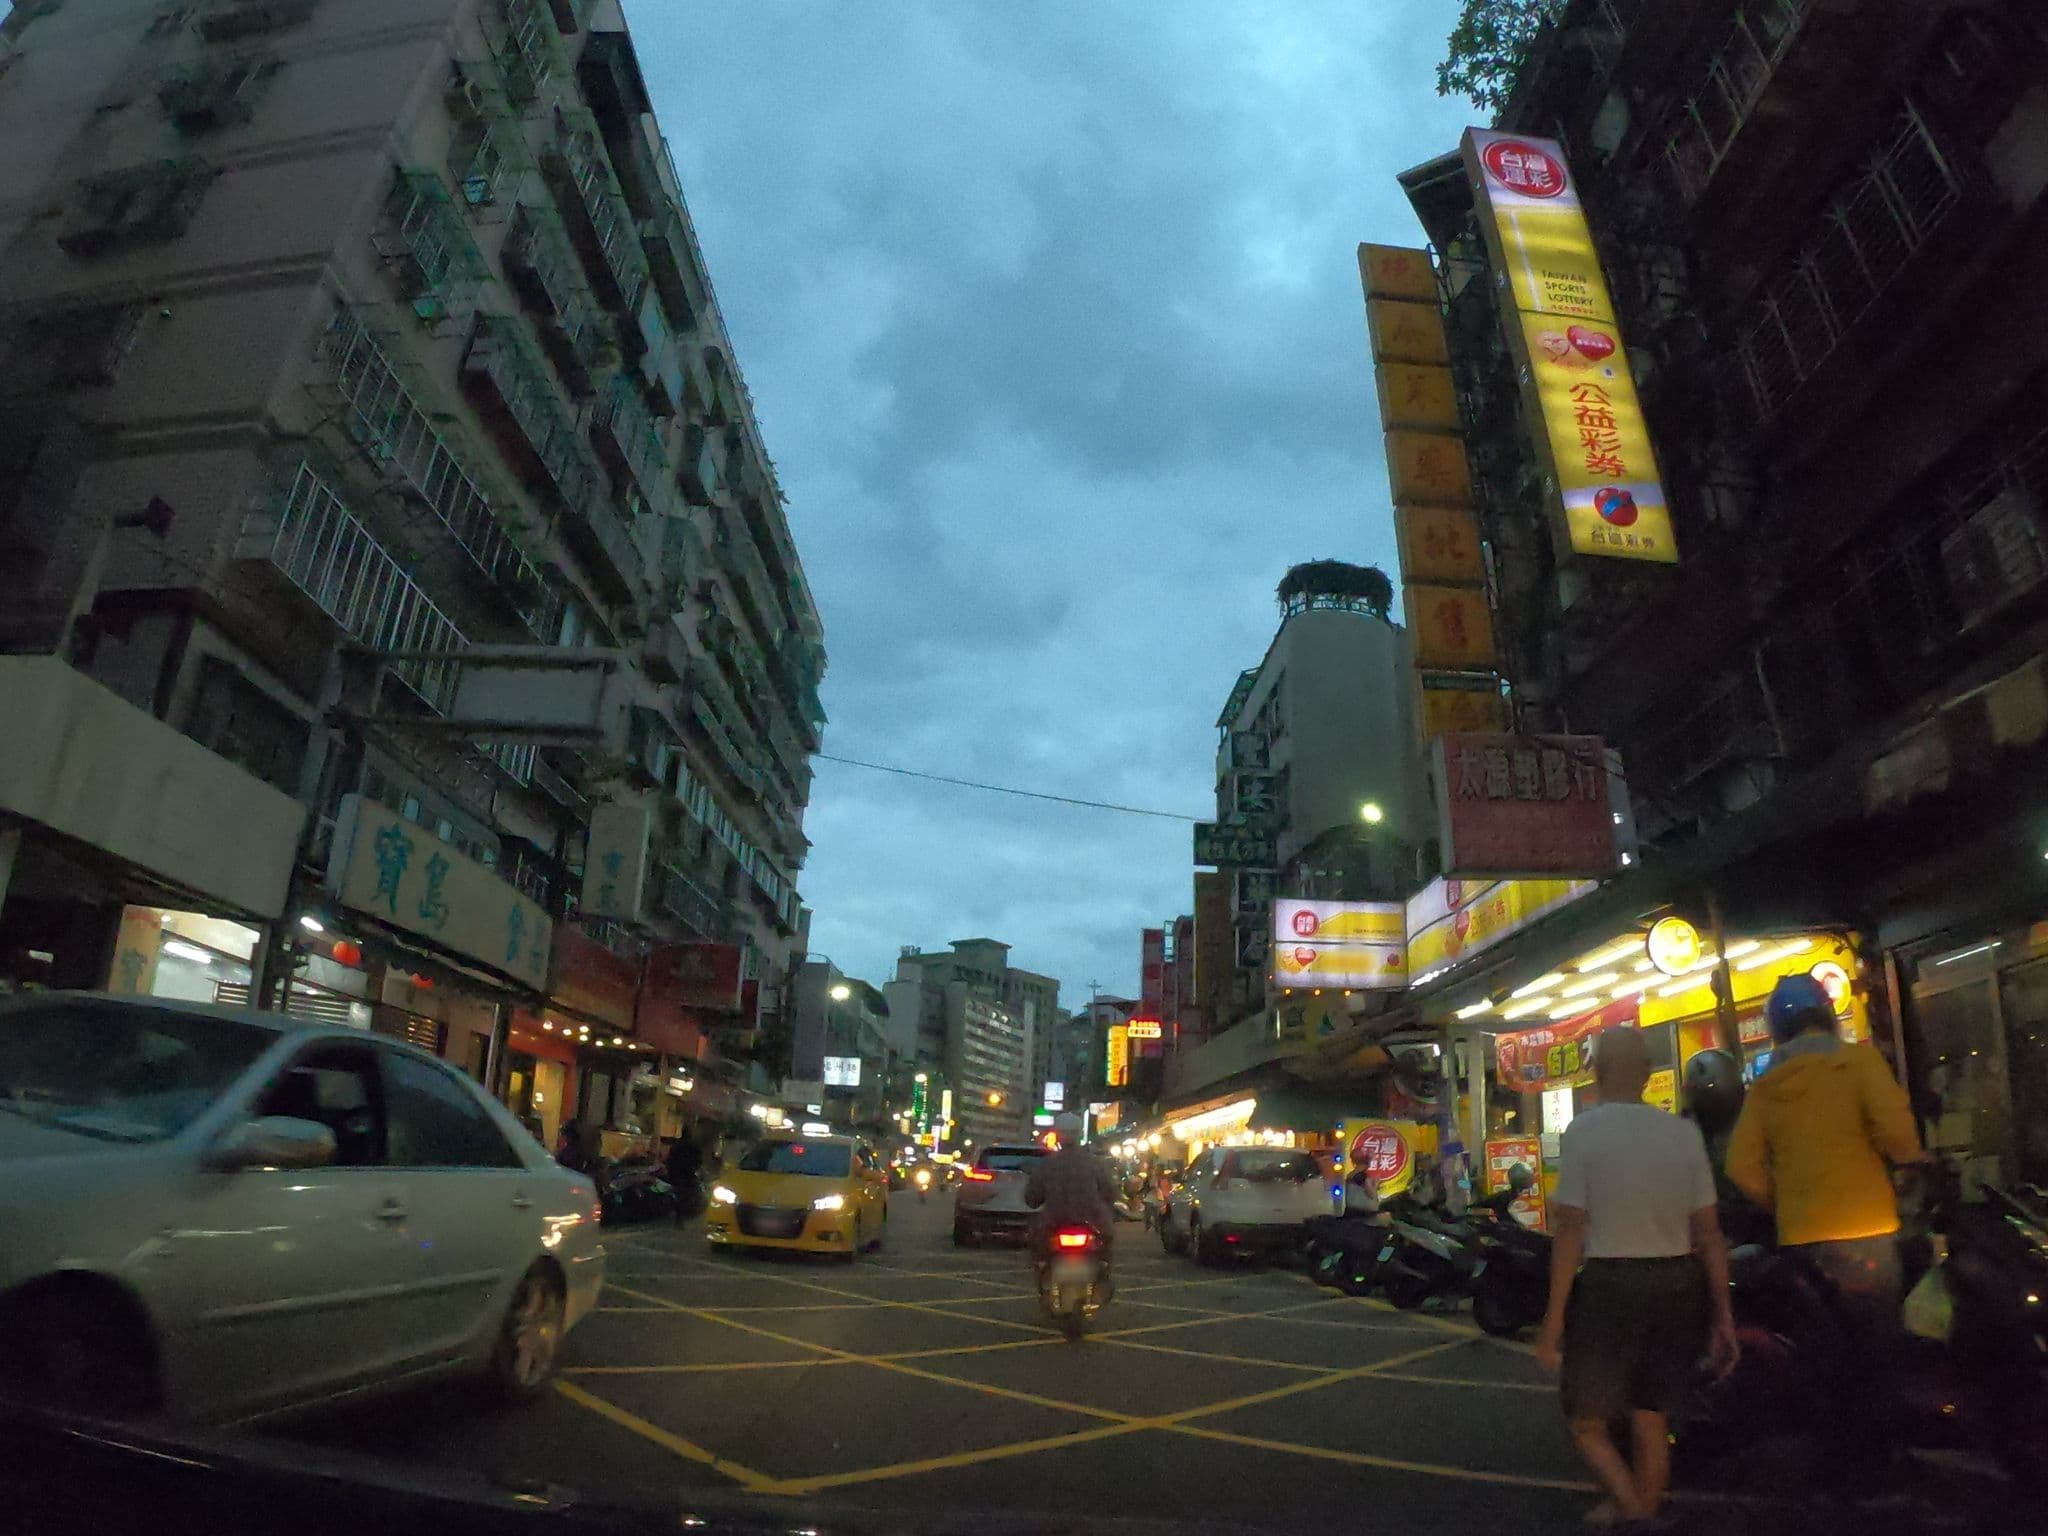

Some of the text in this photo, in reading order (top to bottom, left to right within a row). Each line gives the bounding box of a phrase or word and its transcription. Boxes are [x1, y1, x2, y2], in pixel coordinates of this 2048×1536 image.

[1542, 269, 1587, 283] TAIWAN
[1545, 281, 1586, 295] SPORTS
[1548, 293, 1594, 306] LOTTERY
